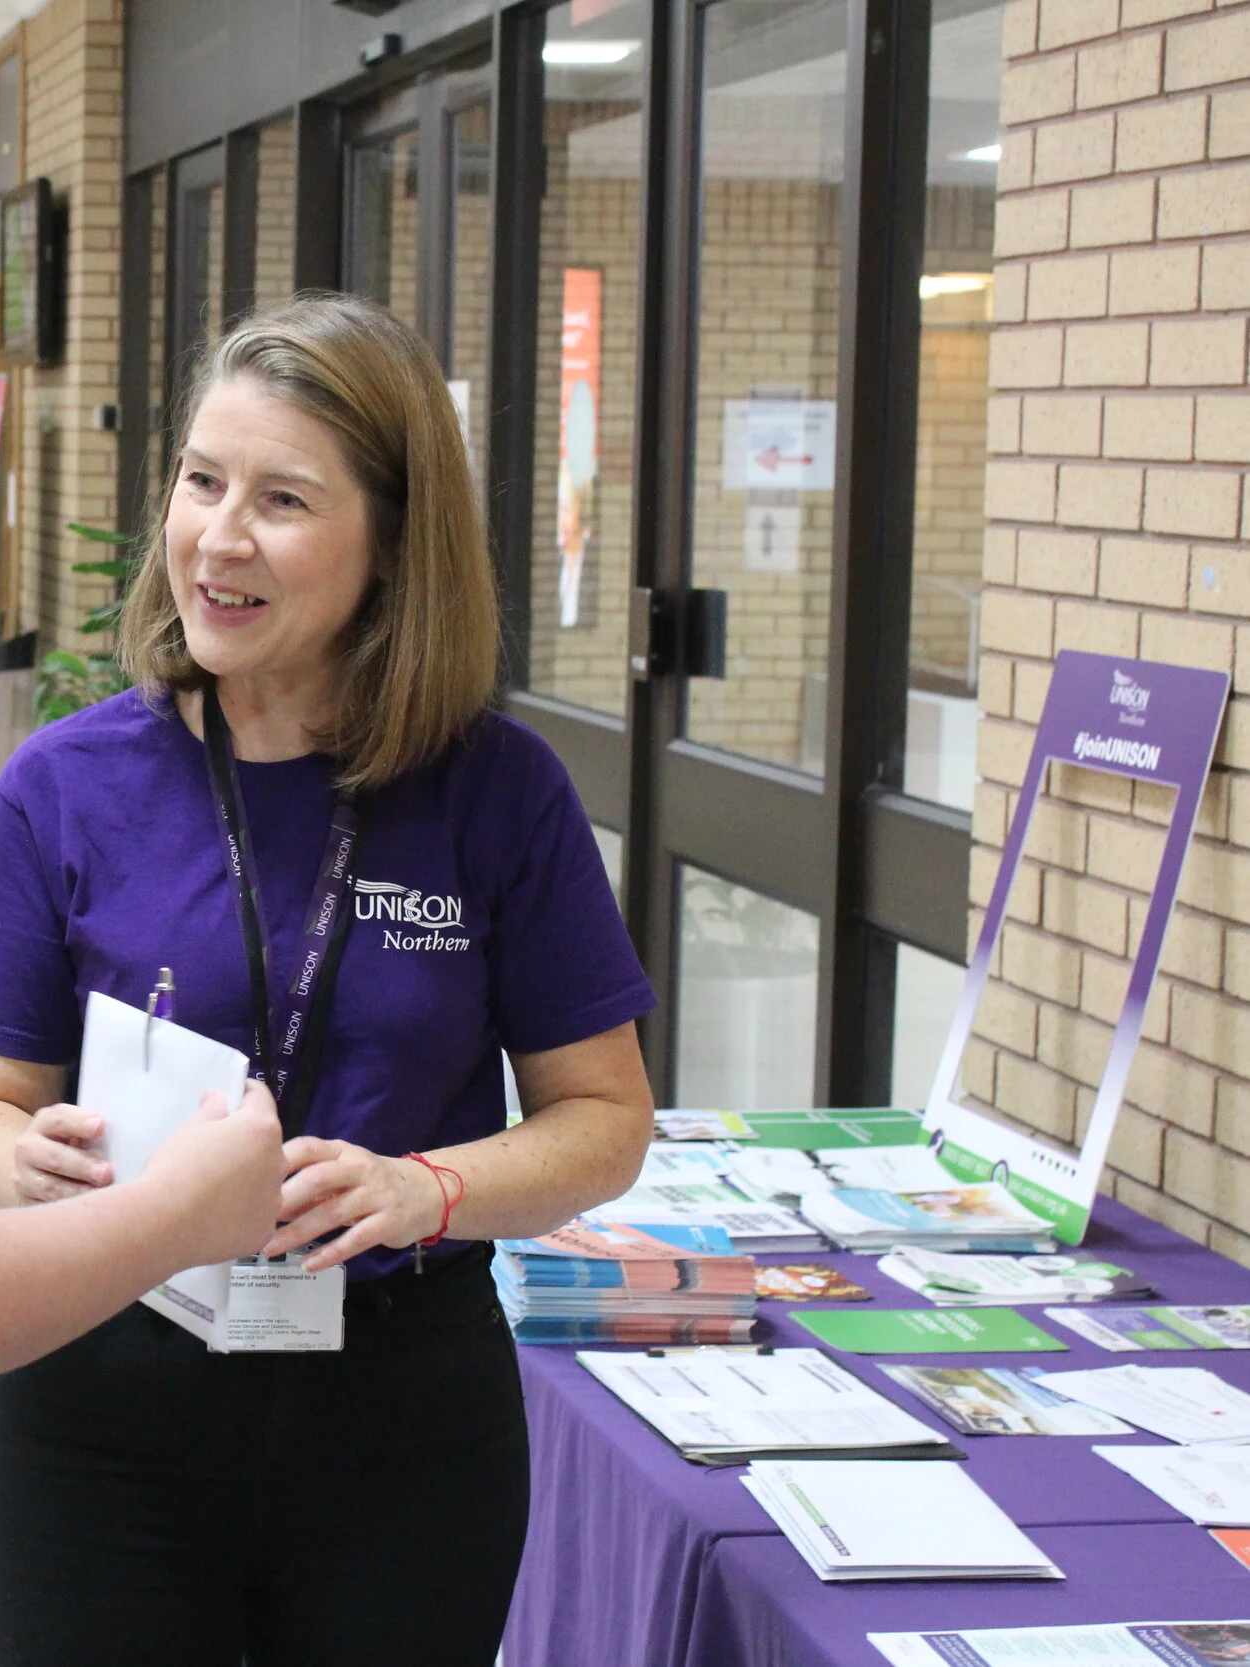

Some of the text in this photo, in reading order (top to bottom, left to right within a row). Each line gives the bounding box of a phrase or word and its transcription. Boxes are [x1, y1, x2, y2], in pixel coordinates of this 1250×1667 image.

[1109, 684, 1151, 711] UNISON
[1072, 731, 1162, 771] #joinUNISON
[332, 837, 352, 879] UNISON
[314, 892, 337, 936] UNISON
[354, 894, 462, 923] UNISON
[382, 929, 470, 951] Northern
[297, 951, 319, 996] UNISON
[282, 1010, 303, 1055] UNISON
